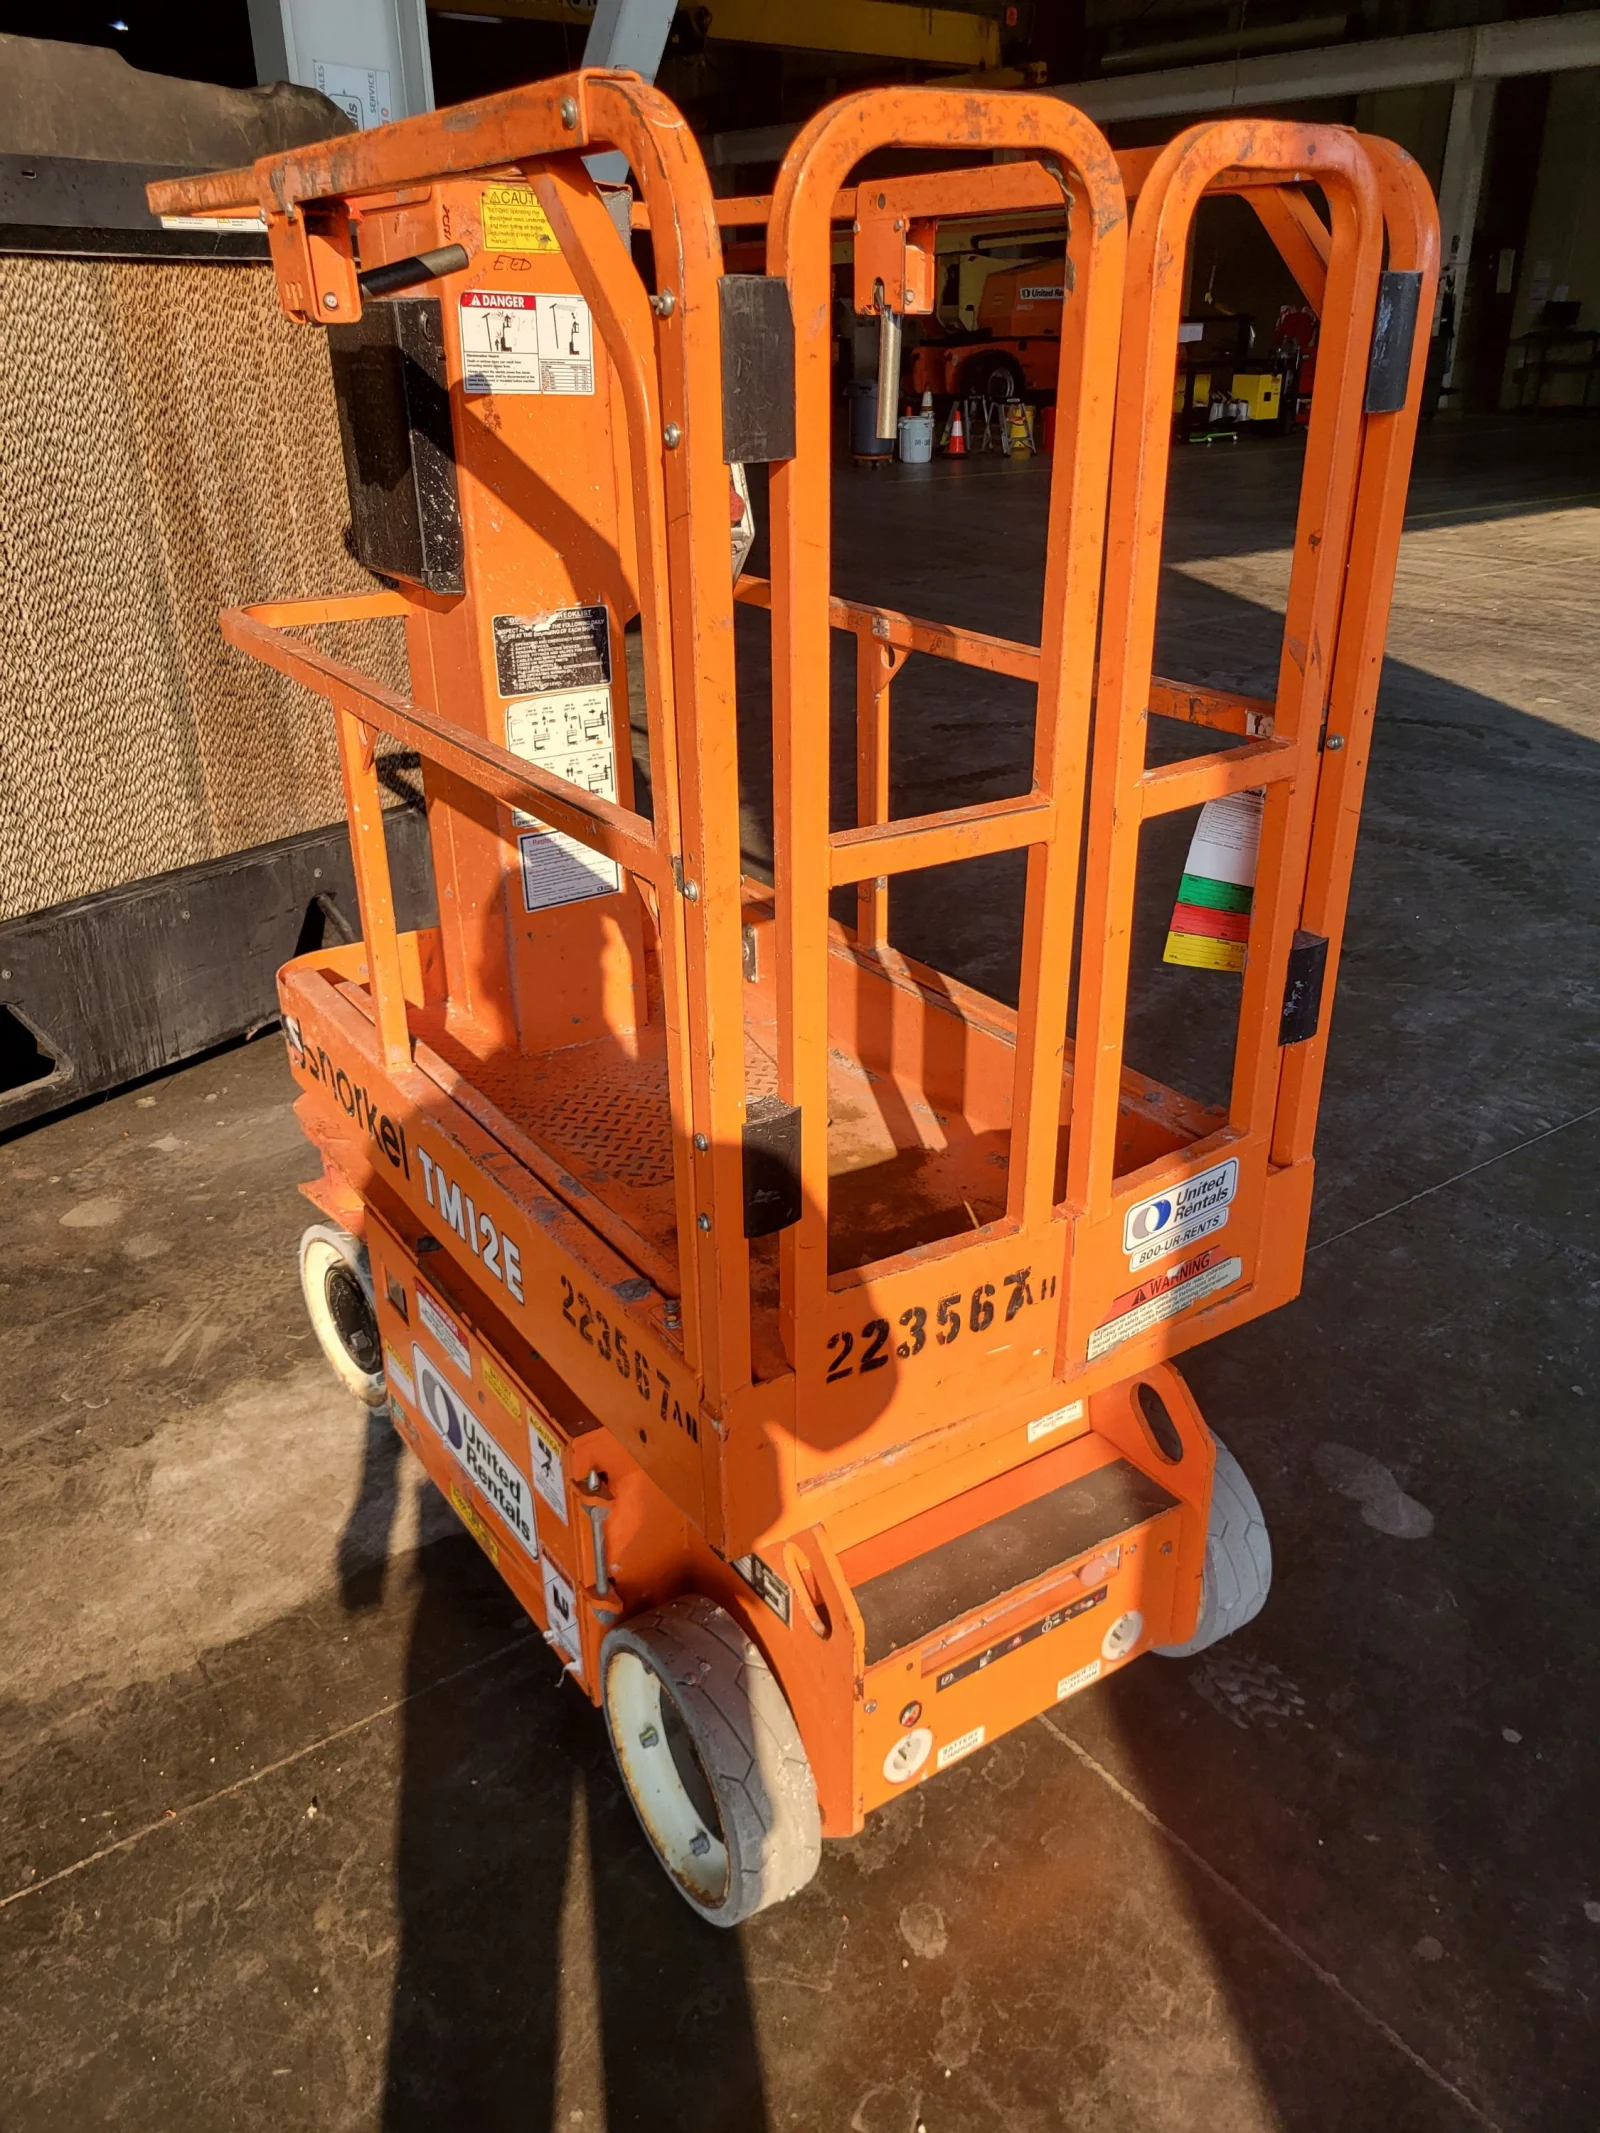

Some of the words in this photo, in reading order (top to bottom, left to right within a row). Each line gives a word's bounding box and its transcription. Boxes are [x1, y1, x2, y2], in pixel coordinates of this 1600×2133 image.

[318, 65, 326, 94] ALES
[368, 72, 376, 114] SERVICE
[482, 294, 525, 308] DANGER
[1031, 288, 1053, 297] United
[1174, 1187, 1228, 1223] Rentals
[1176, 1170, 1227, 1206] United
[417, 1144, 525, 1306] TM12E
[1139, 1215, 1220, 1264] 800-UR-RENTS
[1150, 1252, 1210, 1297] WARNING
[463, 1413, 521, 1504] United
[466, 1444, 531, 1541] Rentals
